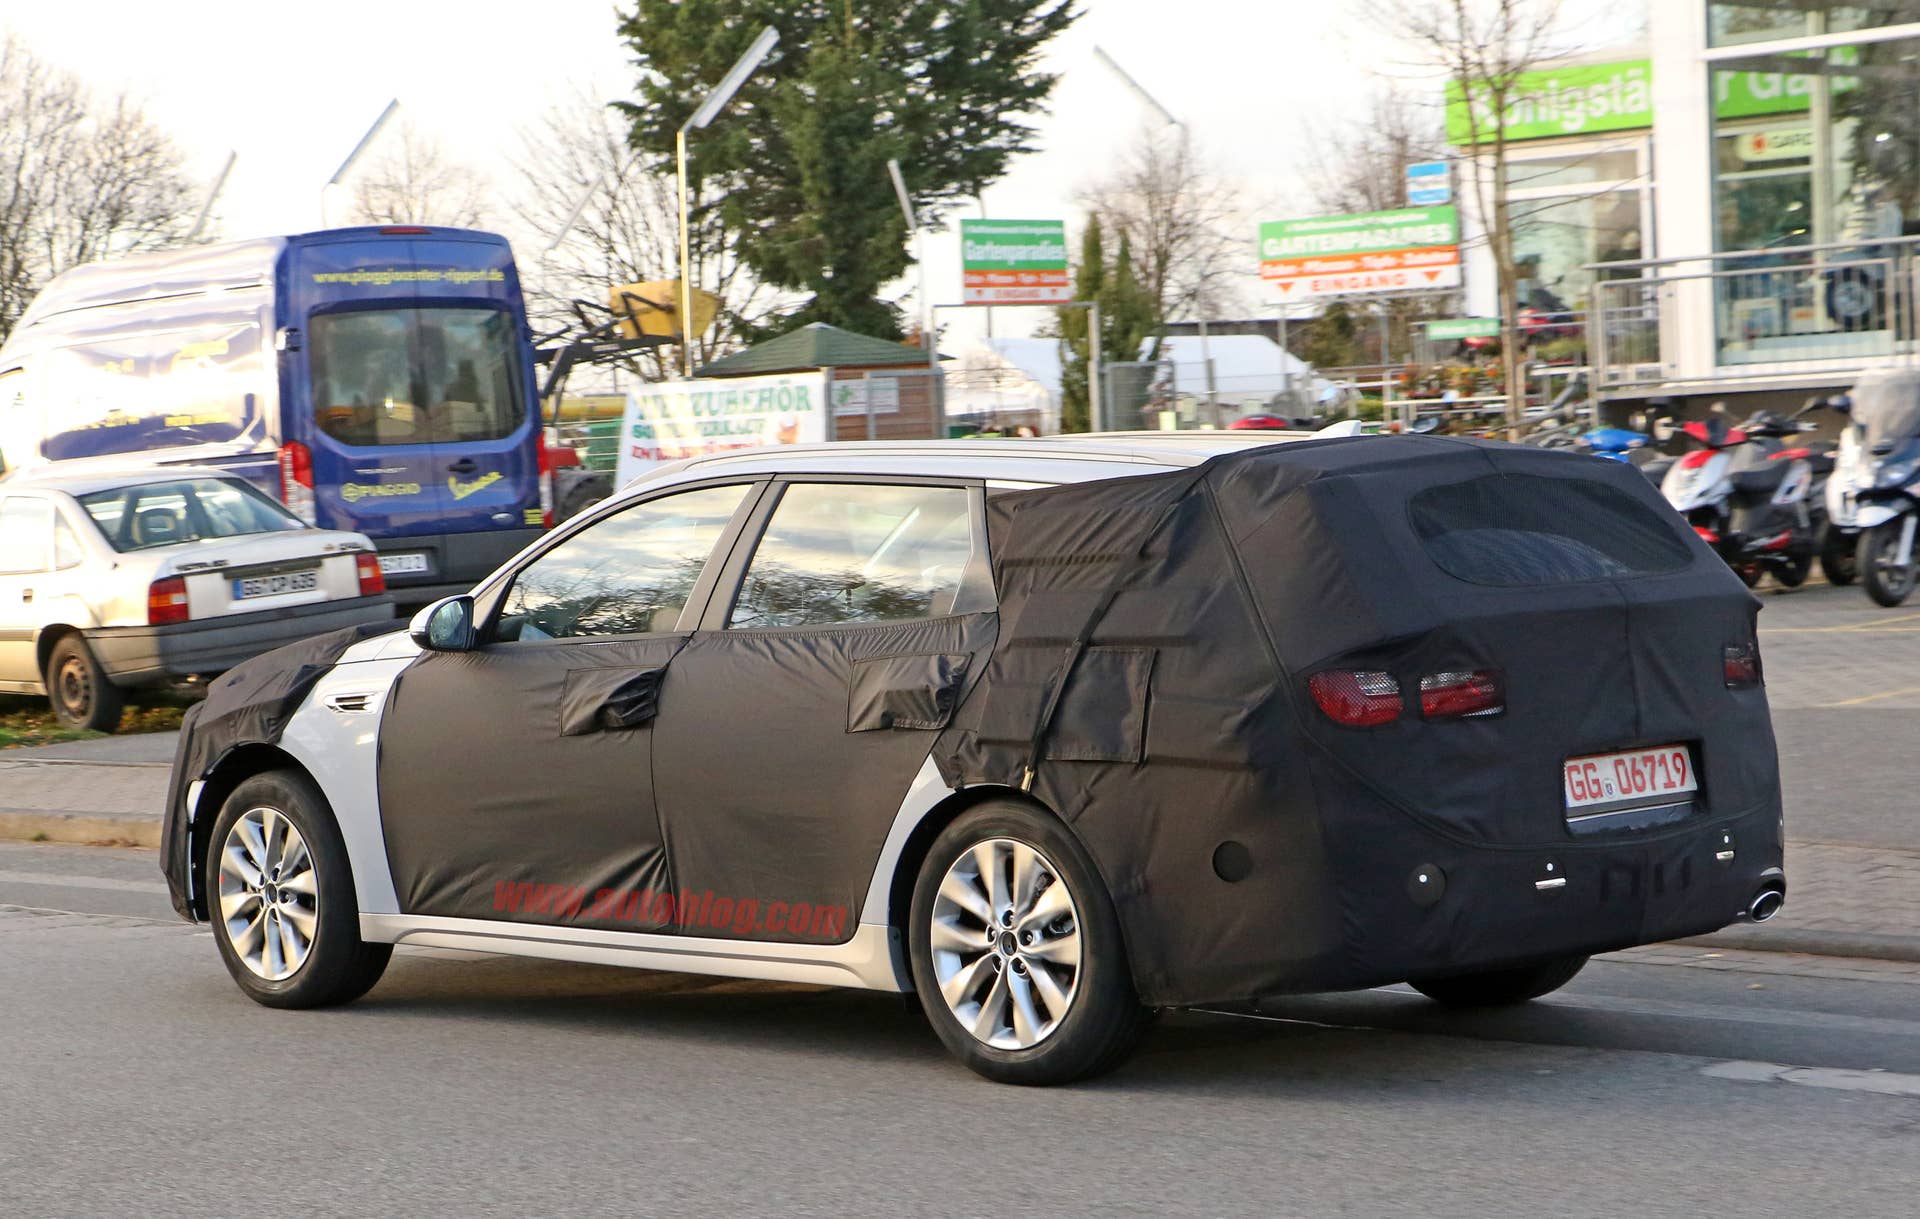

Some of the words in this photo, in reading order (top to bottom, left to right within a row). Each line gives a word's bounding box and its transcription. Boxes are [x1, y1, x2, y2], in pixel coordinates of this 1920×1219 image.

[1312, 272, 1408, 292] EINGANG
[1567, 763, 1604, 801] GG
[1613, 752, 1687, 795] 06719
